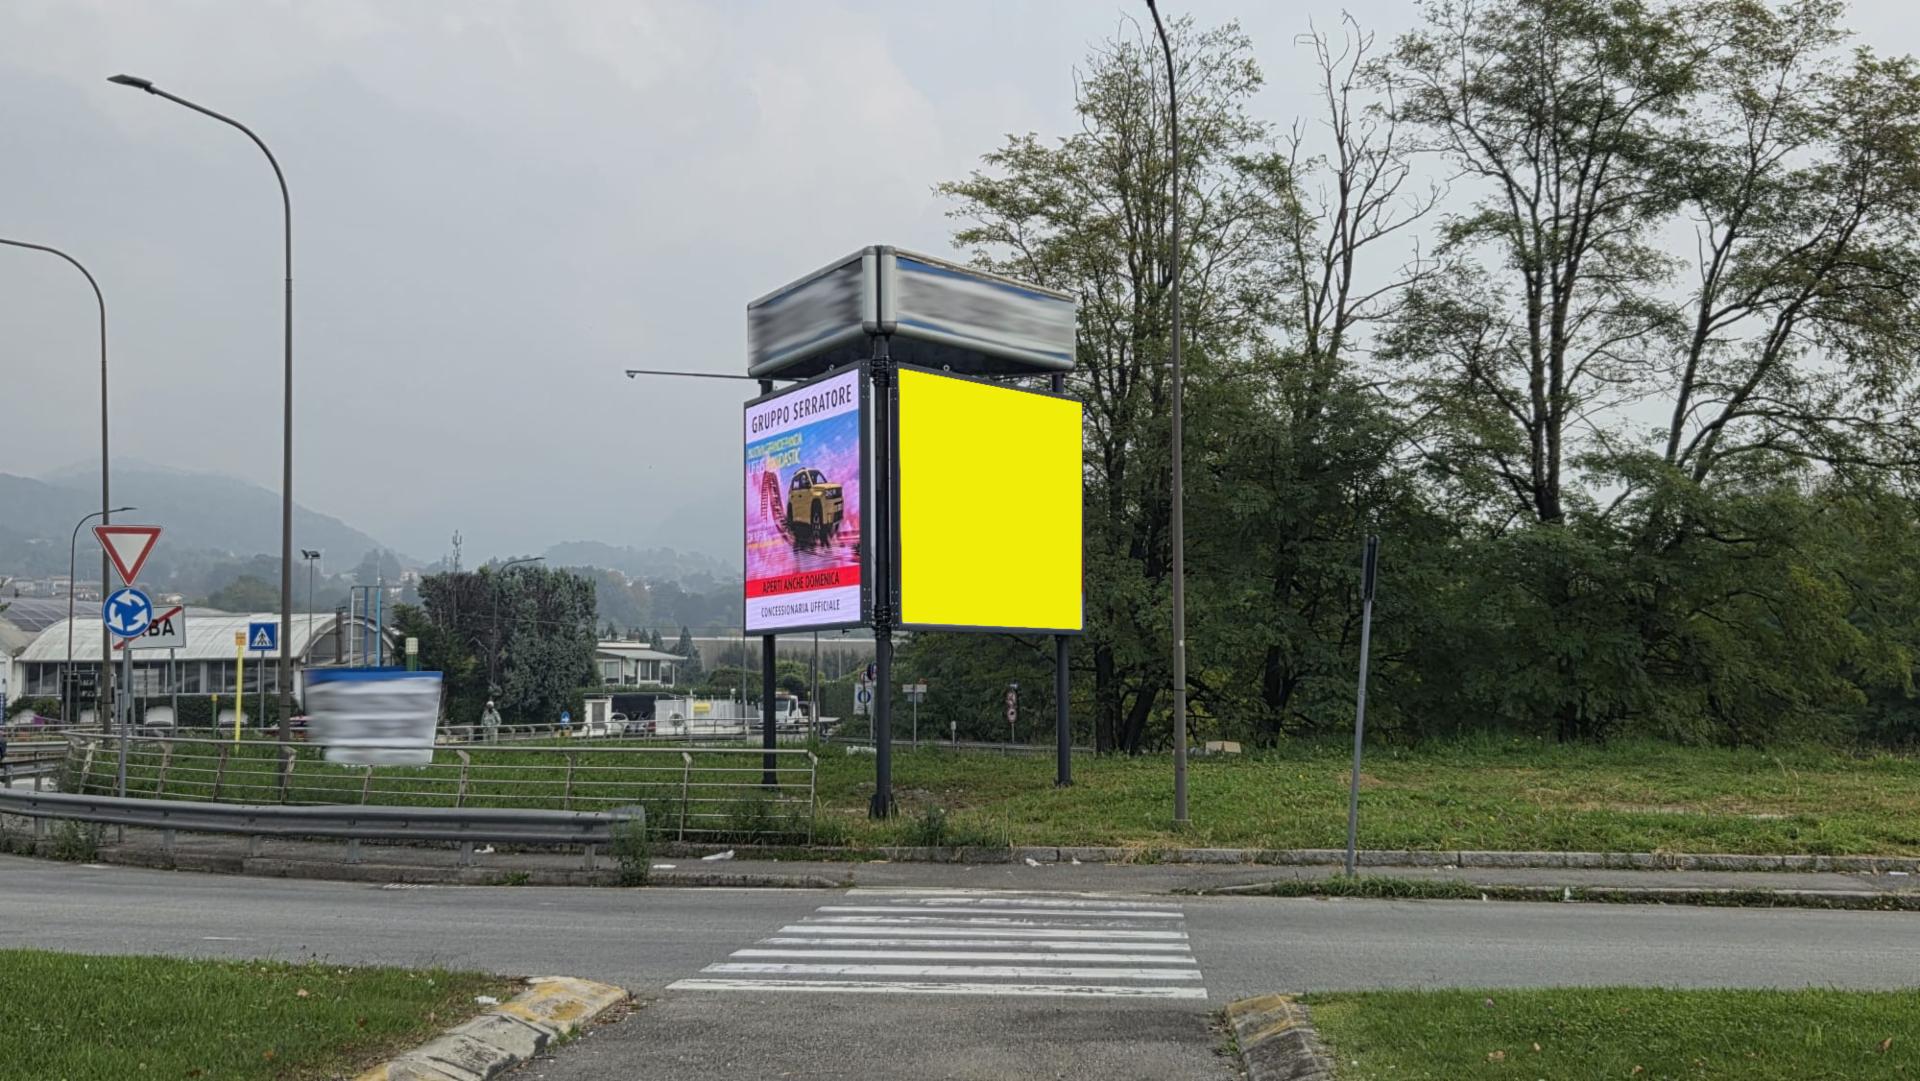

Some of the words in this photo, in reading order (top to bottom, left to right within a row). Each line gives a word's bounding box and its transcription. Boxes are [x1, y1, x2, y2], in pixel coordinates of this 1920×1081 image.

[752, 405, 790, 433] GRUPPO
[793, 384, 852, 420] SERRATORE
[762, 579, 782, 593] APERTI
[784, 576, 804, 591] ANCHE
[806, 572, 840, 588] DOMENICA
[761, 603, 808, 618] CONCESSIONARIA
[810, 599, 841, 613] UFFICIALE
